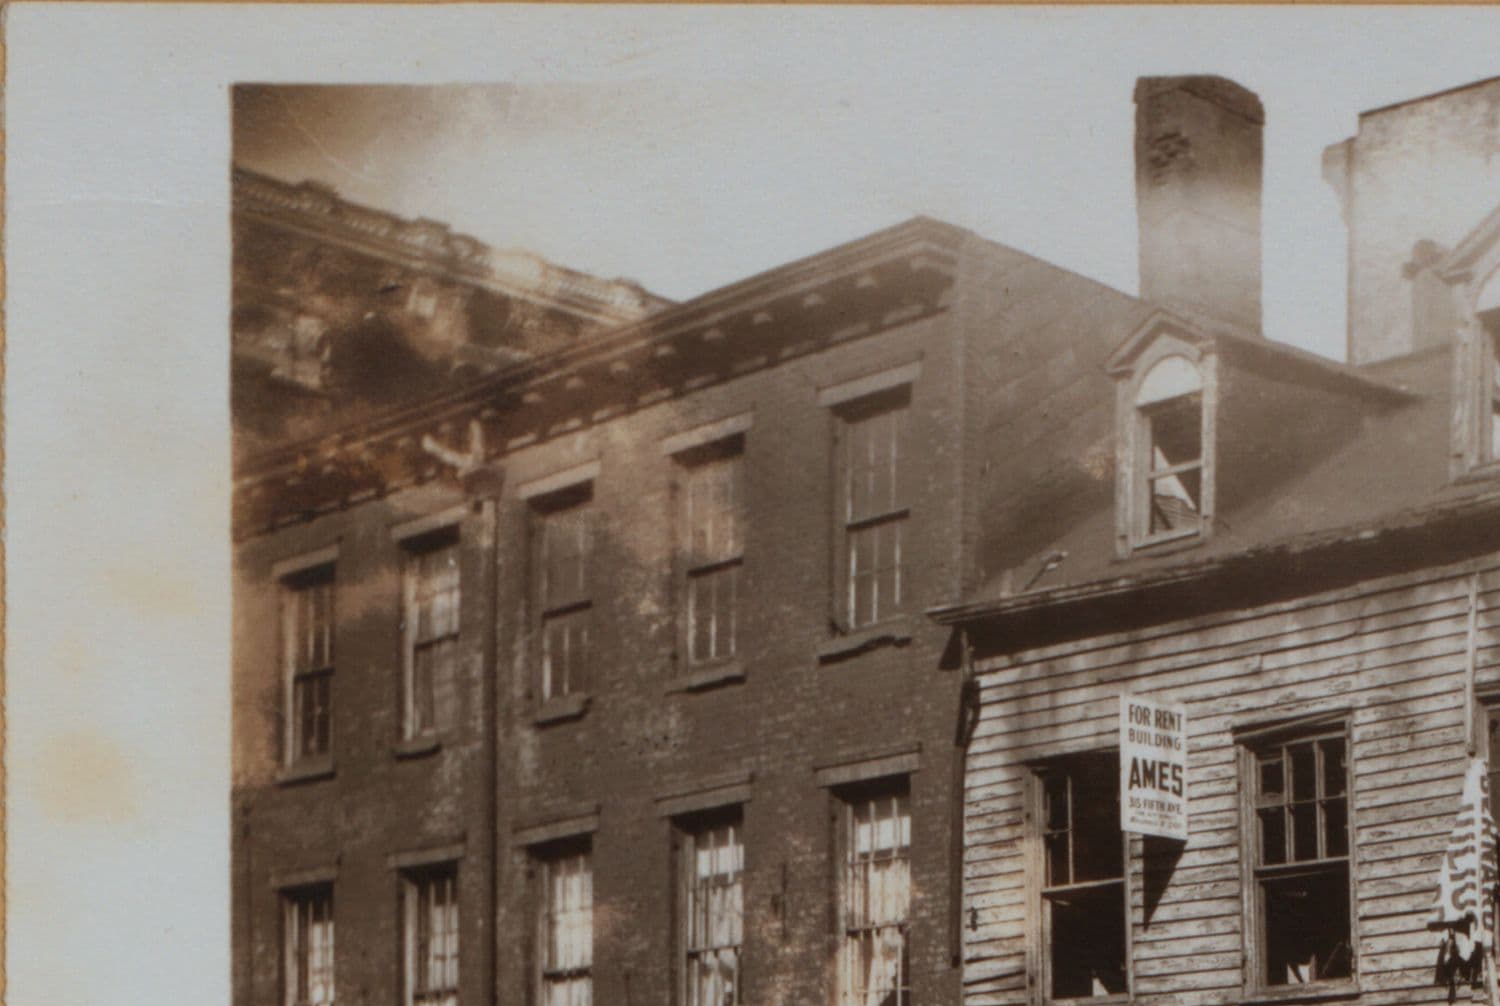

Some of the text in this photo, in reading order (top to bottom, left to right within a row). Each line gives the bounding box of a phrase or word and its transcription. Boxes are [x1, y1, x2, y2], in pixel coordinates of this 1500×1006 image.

[1128, 703, 1183, 732] FOR RENT
[1128, 728, 1182, 751] BUILDING
[1128, 757, 1184, 798] AMES
